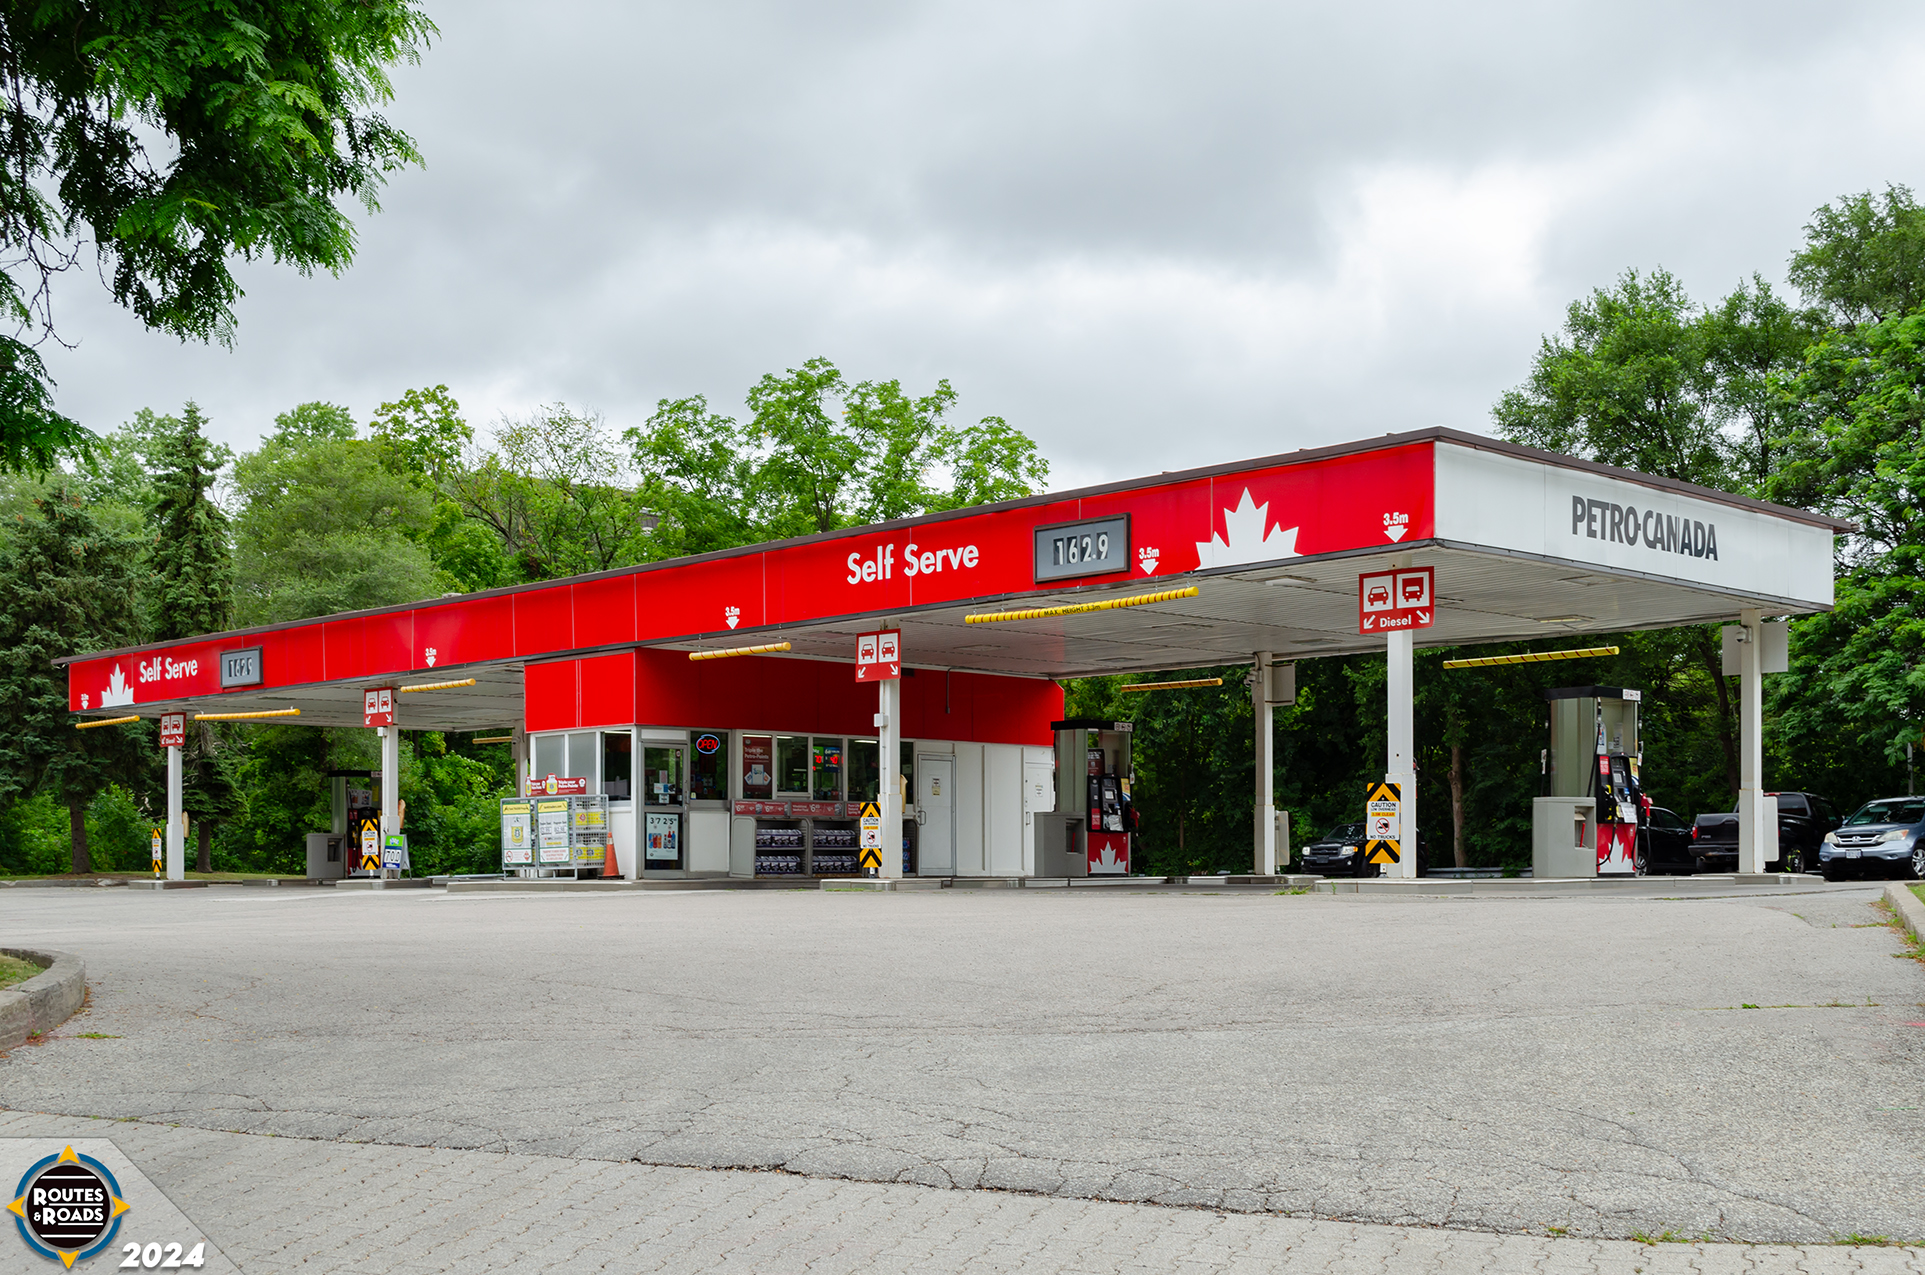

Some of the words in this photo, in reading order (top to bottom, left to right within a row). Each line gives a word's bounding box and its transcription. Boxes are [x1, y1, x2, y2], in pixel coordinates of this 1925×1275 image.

[1383, 512, 1409, 526] 3.5m
[1139, 547, 1160, 560] 3.5m
[847, 544, 894, 584] Self
[904, 544, 979, 577] Serve
[725, 606, 740, 617] 3.5m
[1062, 606, 1084, 614] HEIGHT
[1380, 614, 1411, 628] Diesel
[140, 656, 162, 683] Self
[165, 657, 198, 680] Serve
[697, 739, 718, 749] OPEN
